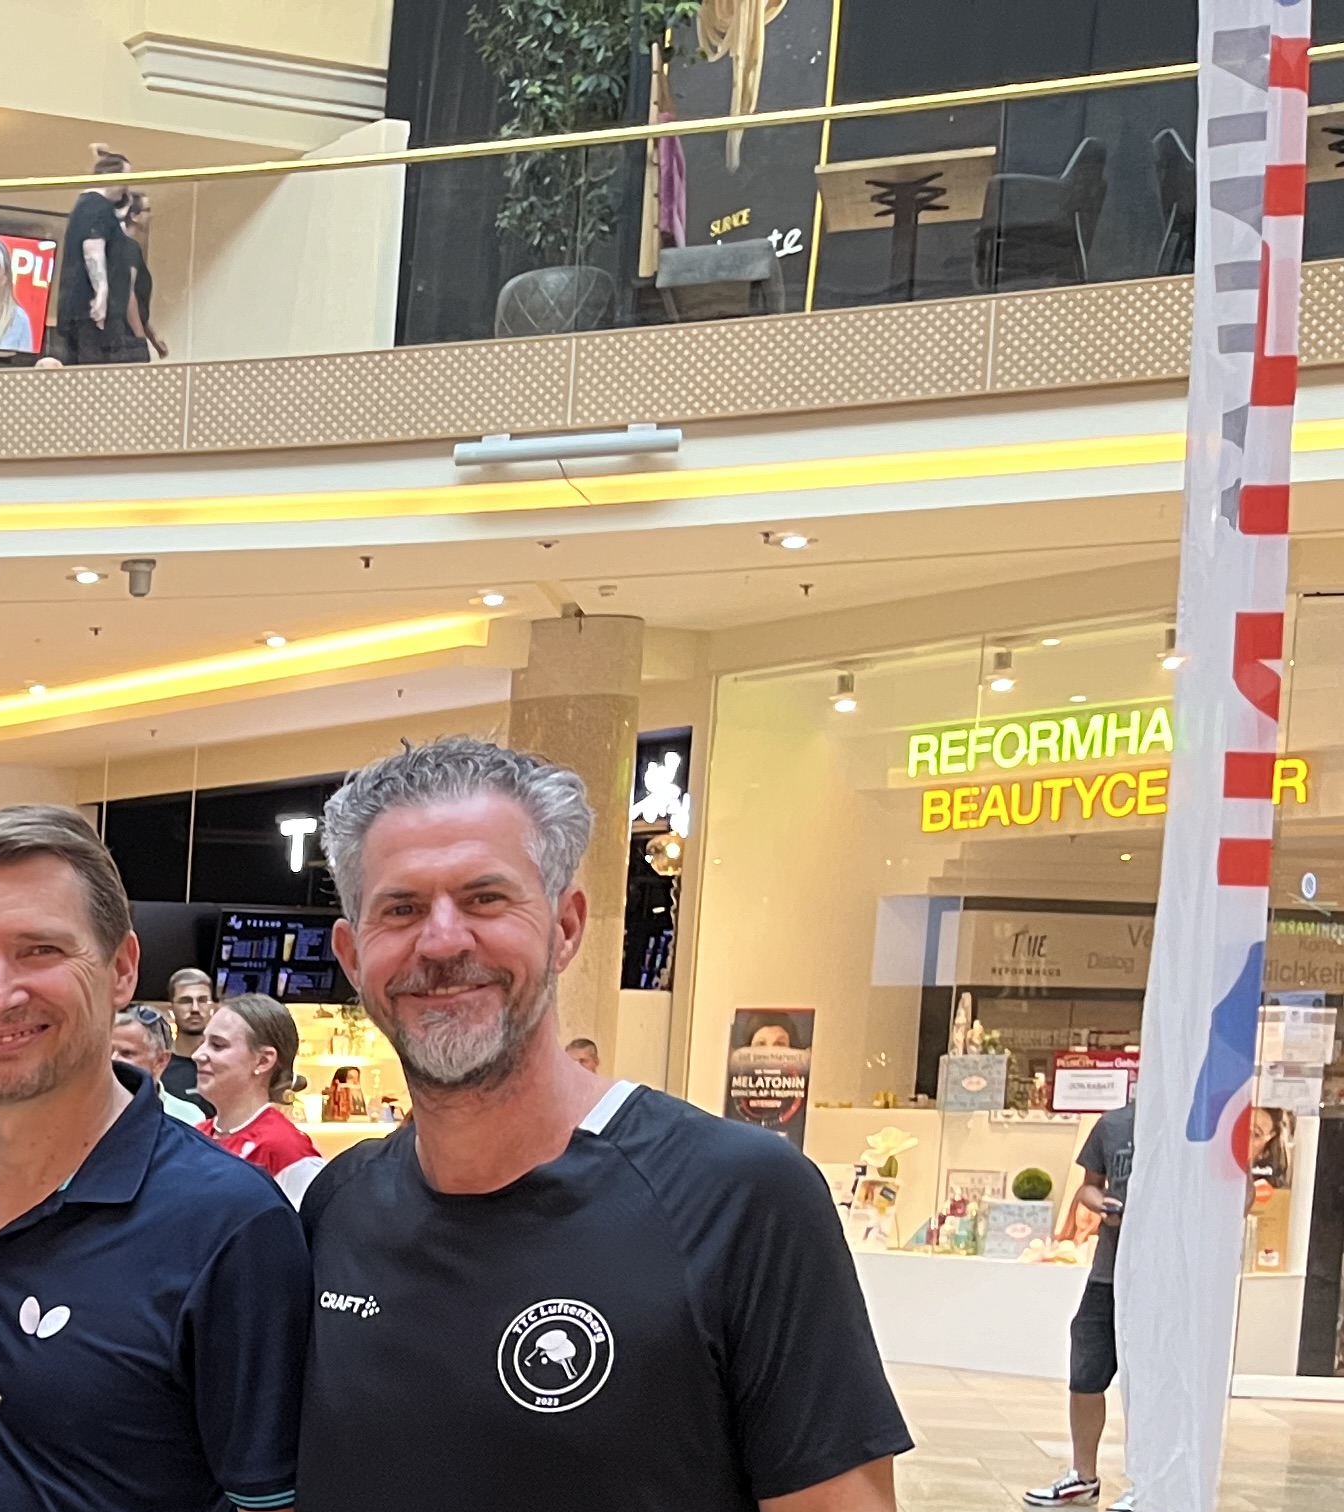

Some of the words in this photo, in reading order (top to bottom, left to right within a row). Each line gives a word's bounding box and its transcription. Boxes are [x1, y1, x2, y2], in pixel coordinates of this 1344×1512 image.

[907, 706, 1175, 779] REFORMHA
[320, 1291, 365, 1313] CRAFT
[512, 1310, 538, 1334] TTC
[539, 1303, 606, 1343] Luftenberg
